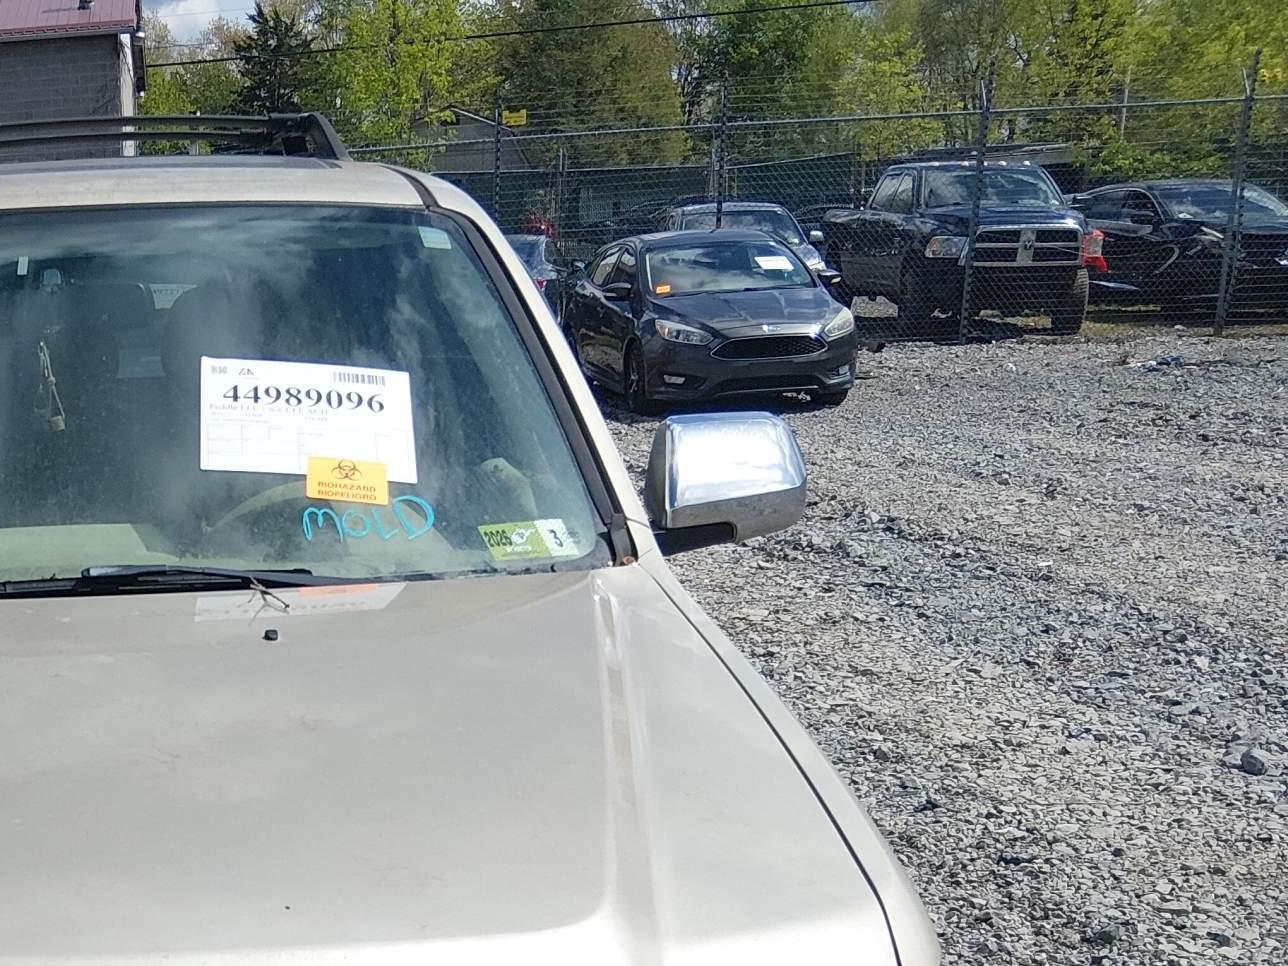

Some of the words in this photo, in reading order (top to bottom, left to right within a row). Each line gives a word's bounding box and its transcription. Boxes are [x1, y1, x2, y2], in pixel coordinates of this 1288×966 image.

[223, 384, 385, 413] 44989096
[317, 480, 377, 493] BIOHAZARD
[317, 489, 377, 501] BIOPELIGRO
[302, 495, 435, 543] MOLD
[483, 529, 513, 548] 2026
[547, 528, 564, 548] 3
